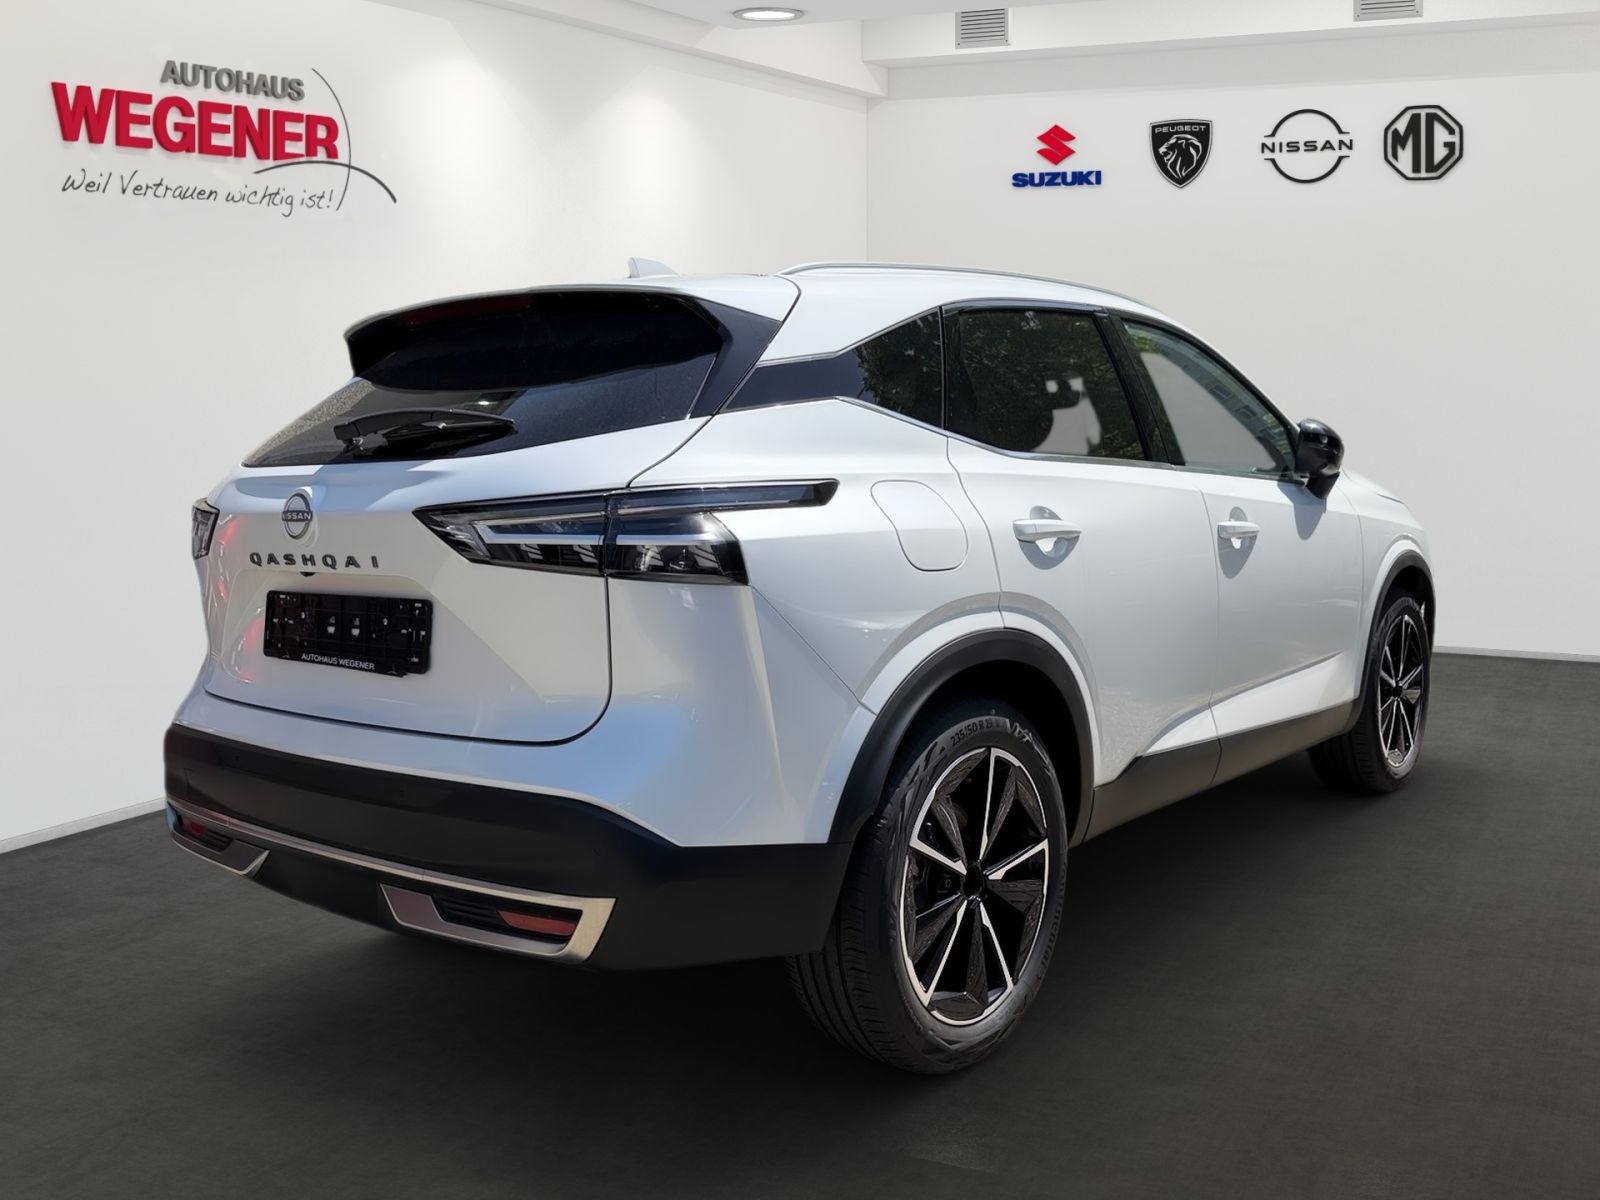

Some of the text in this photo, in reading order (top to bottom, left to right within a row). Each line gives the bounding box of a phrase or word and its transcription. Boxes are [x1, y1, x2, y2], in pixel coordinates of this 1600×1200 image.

[160, 59, 305, 101] AUTOHAUS
[51, 81, 340, 161] WEGENER
[1154, 124, 1207, 134] PEUGEOT
[1260, 138, 1354, 154] NISSAN
[1391, 112, 1456, 174] MG
[1011, 169, 1103, 188] SUZUKI
[62, 168, 334, 218] Weil Vertrauen wichtig ist!
[249, 552, 379, 570] QASHQAI
[301, 652, 376, 671] AUTOHAUS WEGENER
